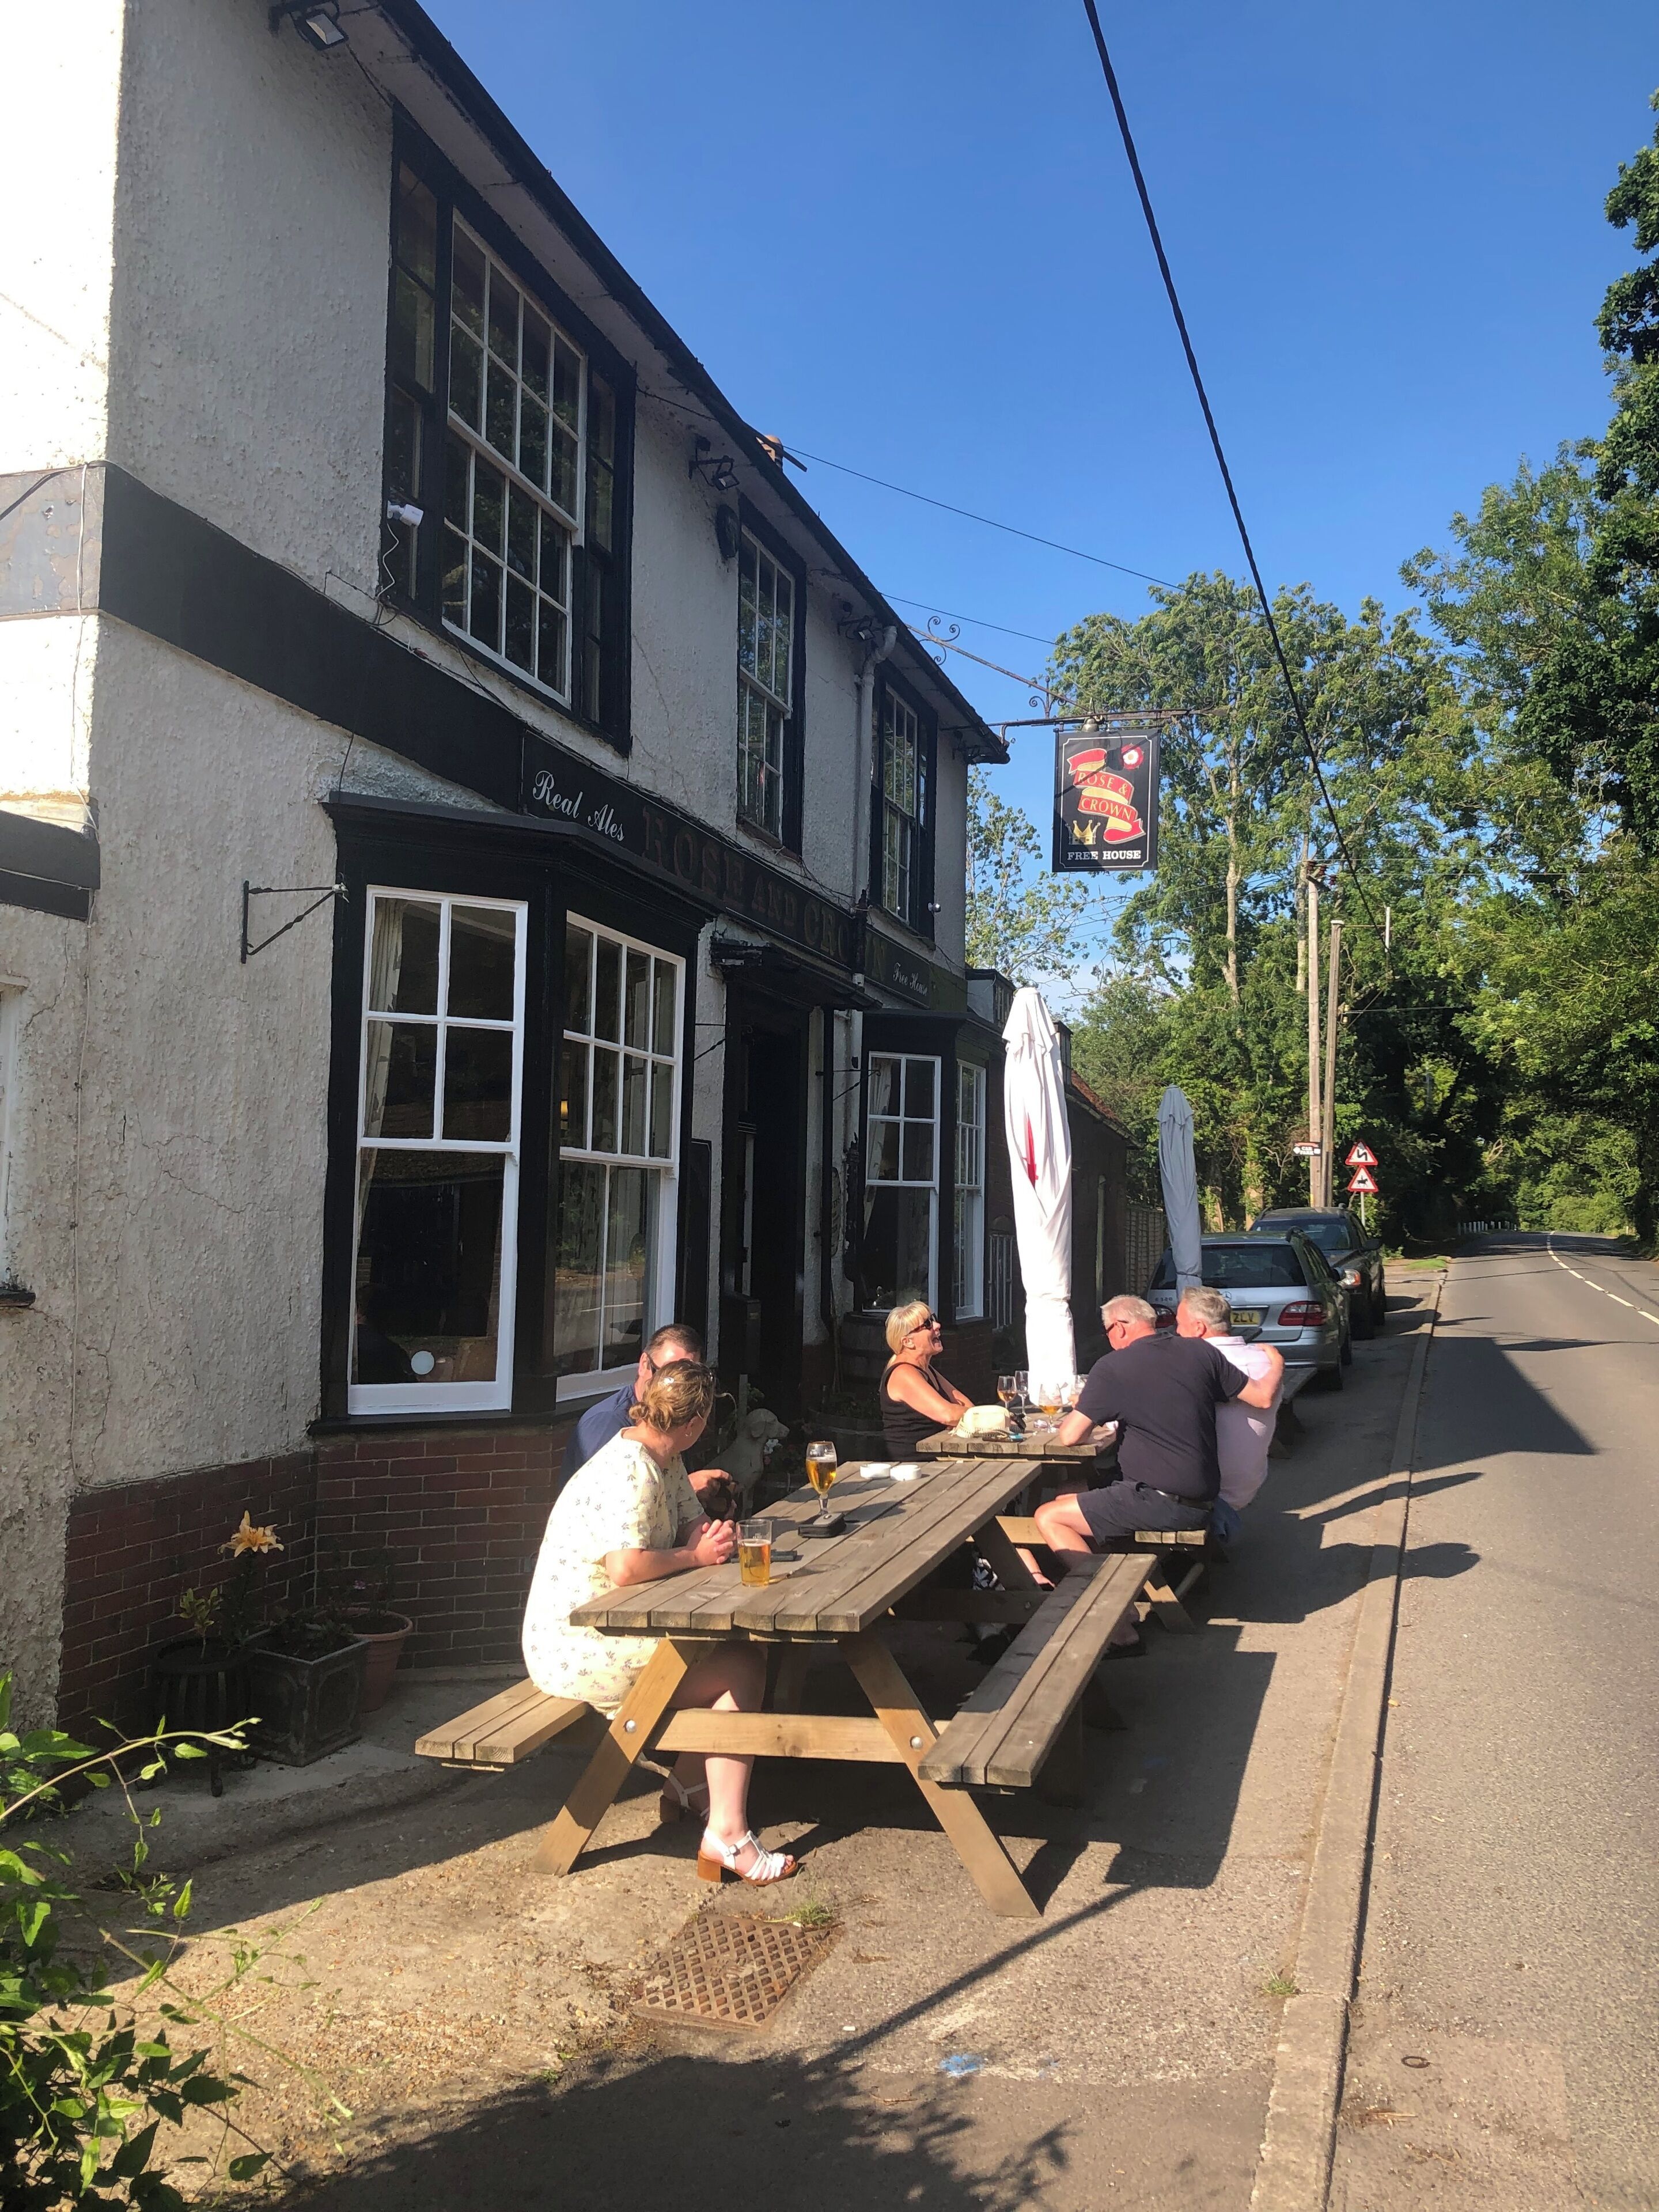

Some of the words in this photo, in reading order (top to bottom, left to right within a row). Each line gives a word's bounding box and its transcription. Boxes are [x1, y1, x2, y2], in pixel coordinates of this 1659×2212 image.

[1078, 772, 1115, 789] ROSE
[1118, 782, 1128, 795] &
[532, 770, 584, 819] Real
[587, 804, 625, 842] Ales
[1081, 797, 1133, 821] CROWN
[642, 805, 745, 910] ROSE
[751, 874, 797, 926] AND
[1067, 851, 1099, 861] FREE
[1102, 850, 1142, 860] HOUSE
[892, 961, 908, 986] Free
[910, 972, 928, 997] House
[1232, 1312, 1255, 1323] ZLV
